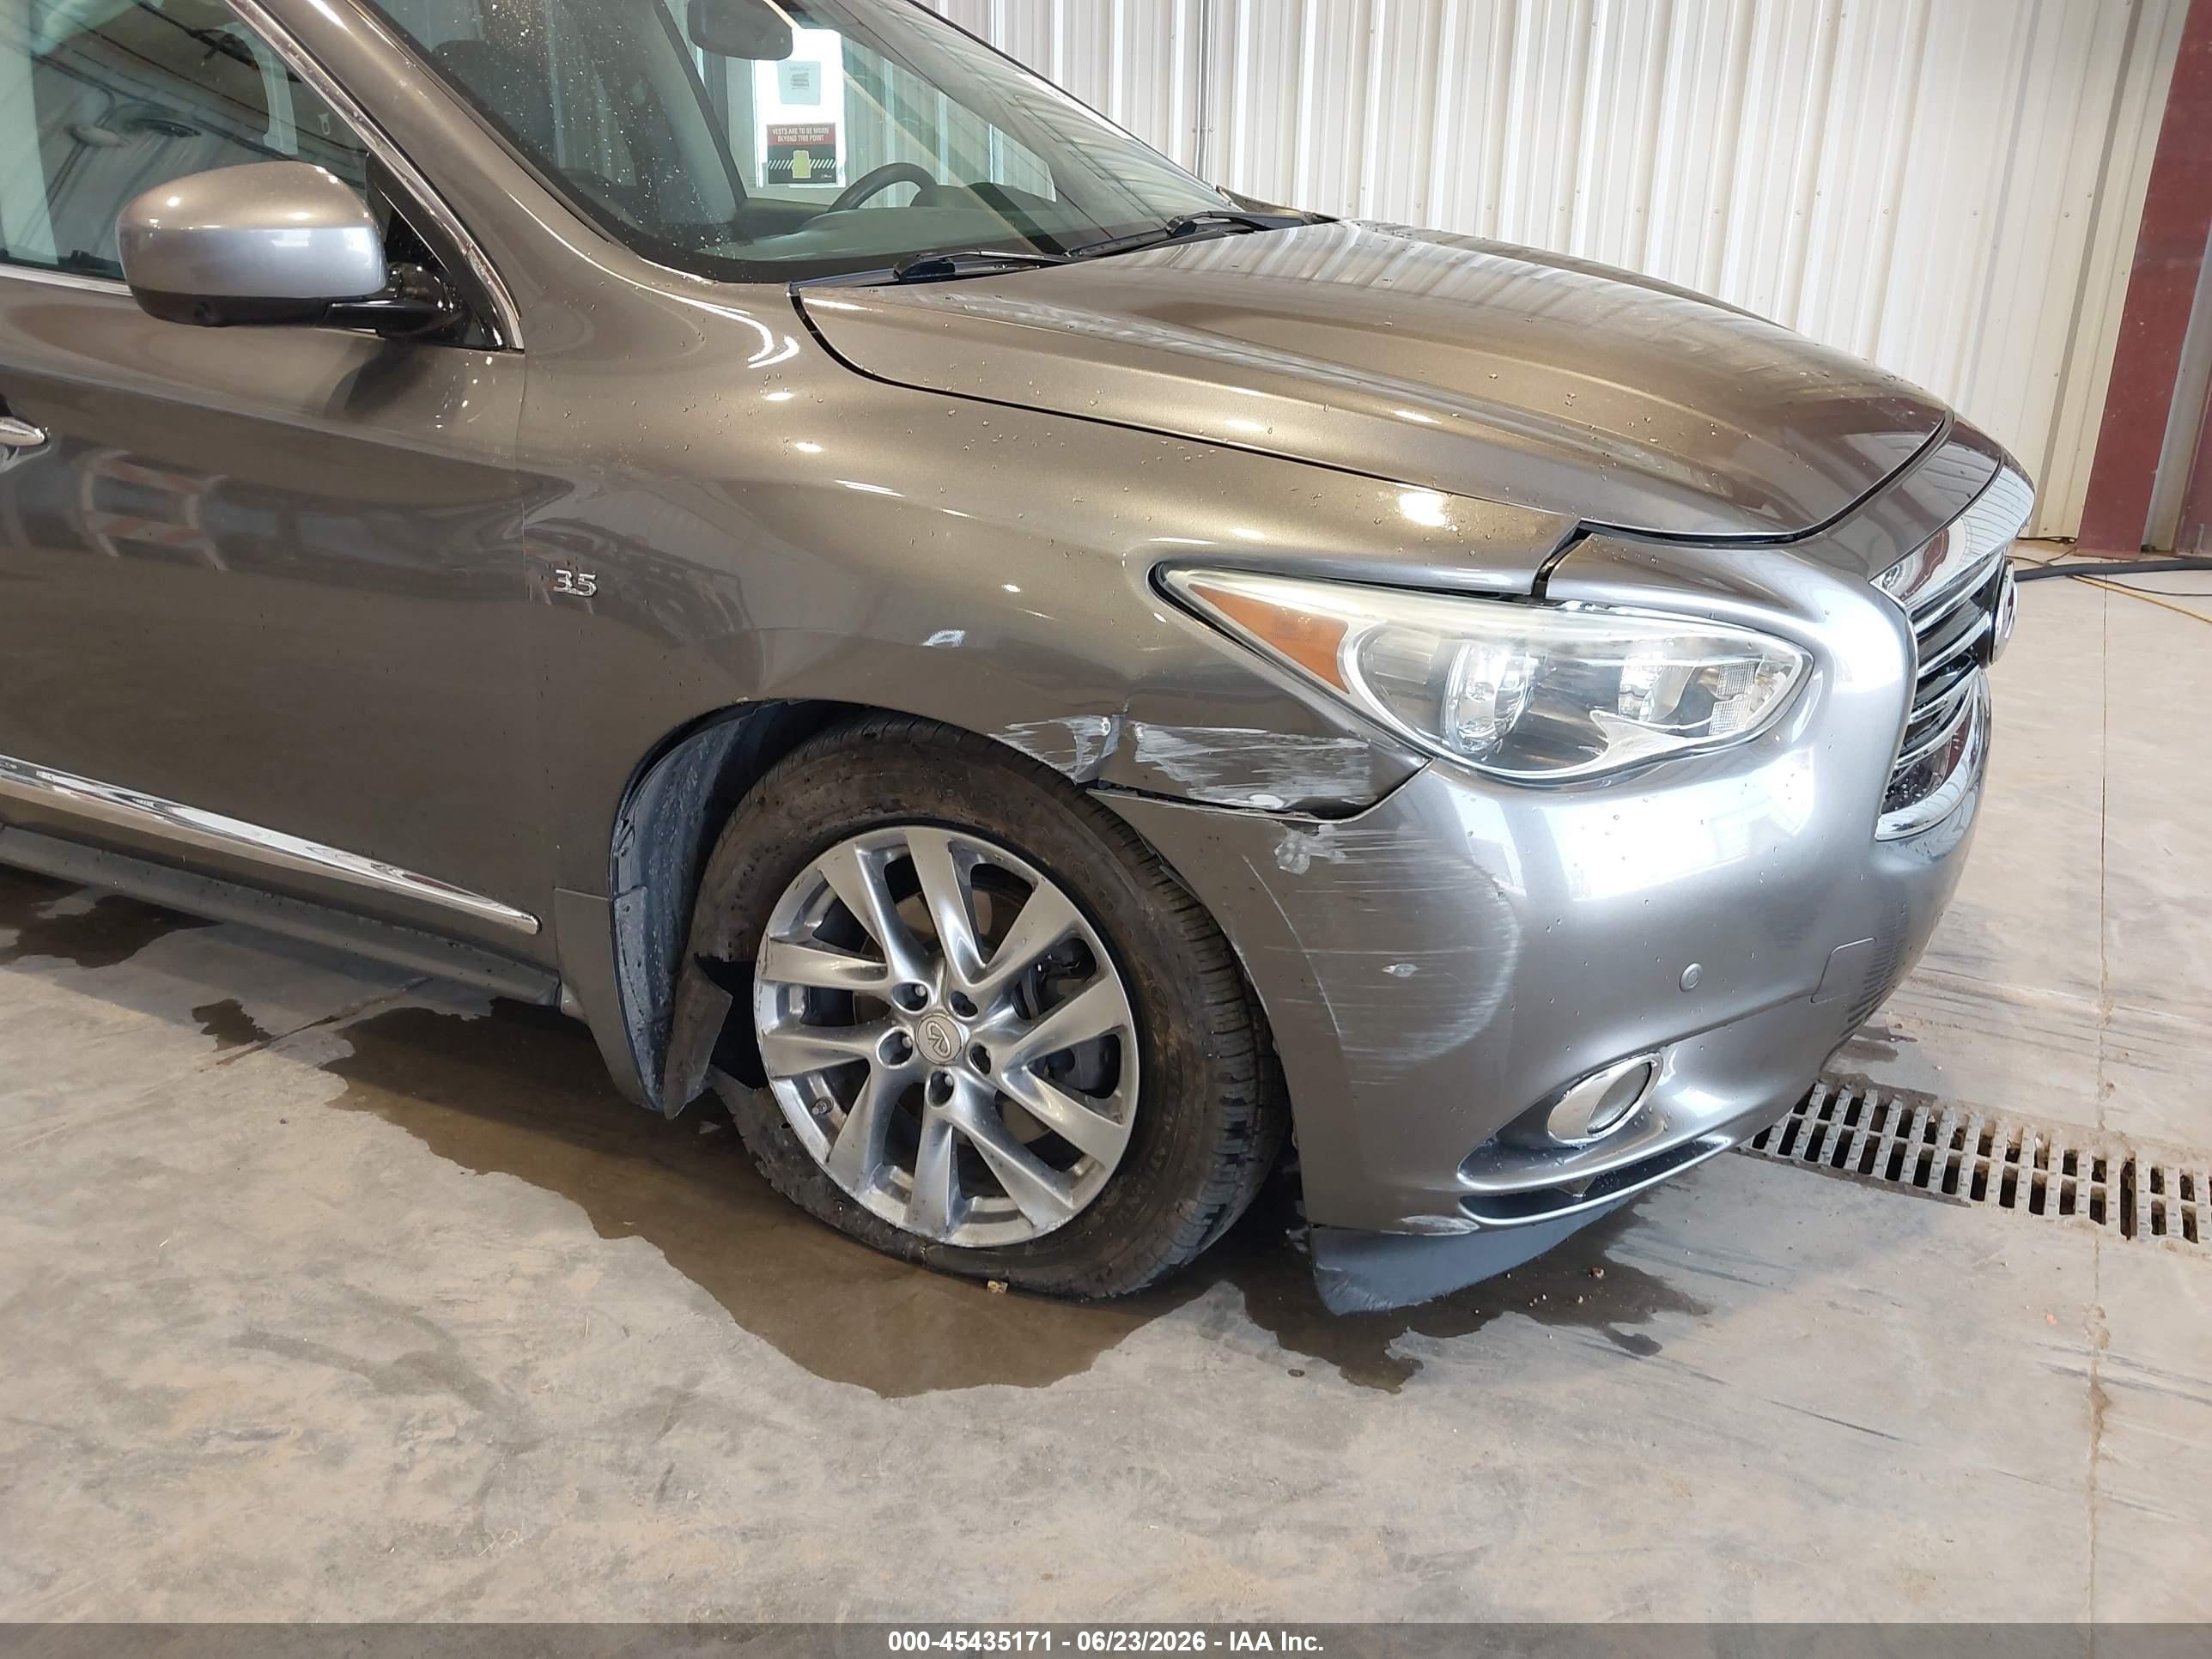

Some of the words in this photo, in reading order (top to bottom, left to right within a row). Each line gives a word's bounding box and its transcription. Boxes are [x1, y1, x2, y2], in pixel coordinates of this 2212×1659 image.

[773, 127, 788, 136] VESTS
[789, 127, 799, 136] ARE
[813, 126, 830, 135] WORN
[809, 134, 824, 143] POINT
